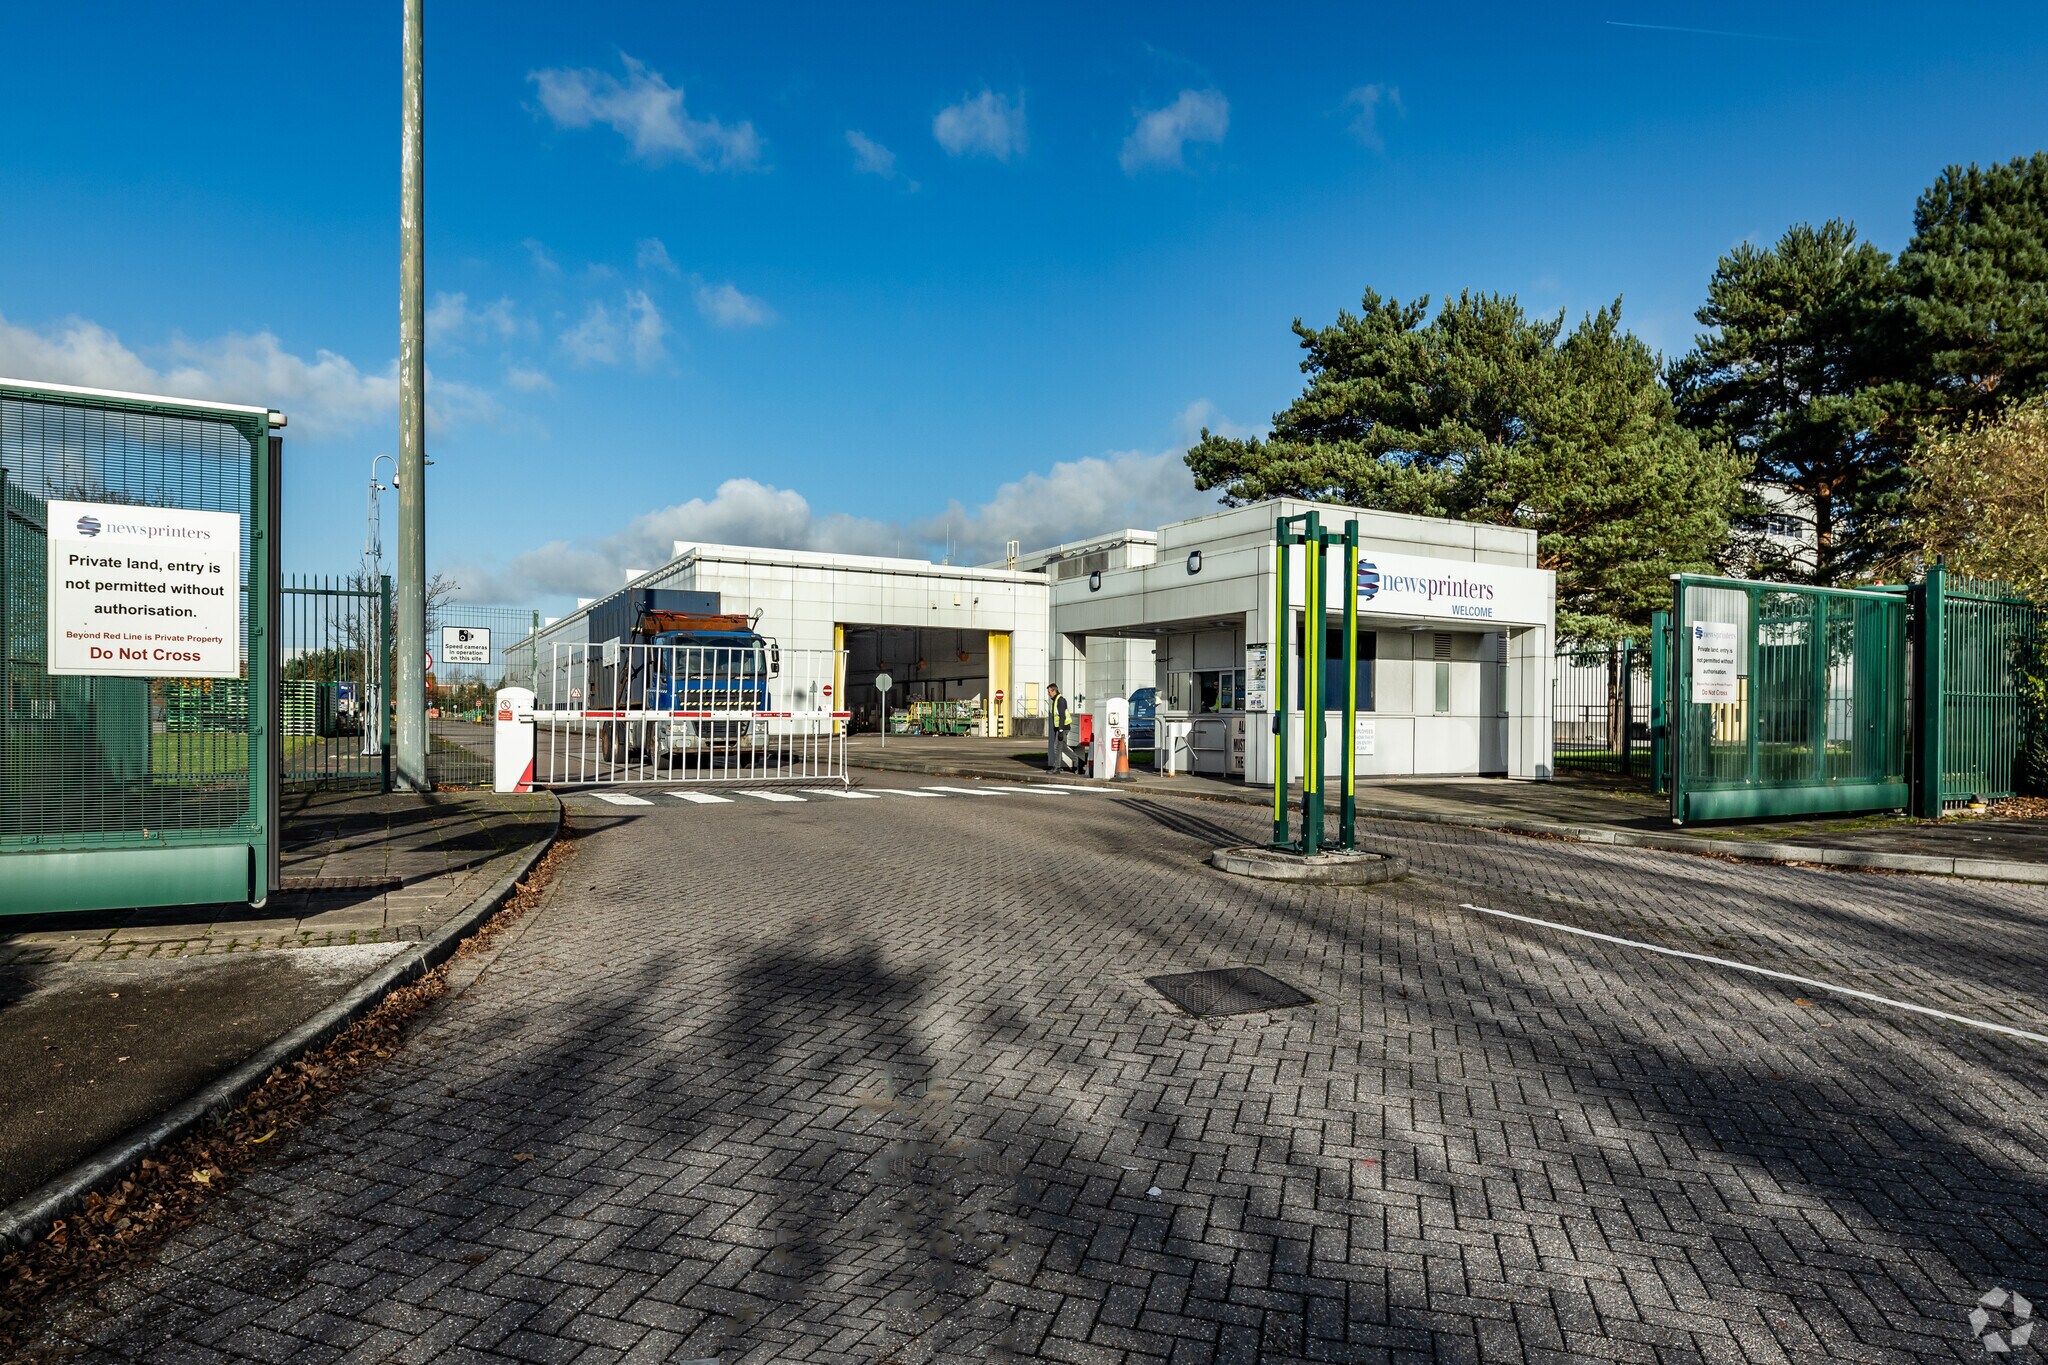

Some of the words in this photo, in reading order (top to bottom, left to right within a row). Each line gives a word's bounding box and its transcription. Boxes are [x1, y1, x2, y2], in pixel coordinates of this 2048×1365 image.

[107, 523, 211, 540] newsprinters
[69, 554, 122, 568] Private
[127, 557, 163, 572] land,
[167, 561, 204, 575] entry
[209, 562, 221, 573] is
[65, 579, 90, 590] not
[95, 580, 166, 594] permitted
[171, 584, 225, 596] without
[1383, 574, 1494, 601] newsprinters
[94, 604, 197, 617] authorisation.
[1451, 604, 1493, 618] WELCOME
[66, 631, 101, 640] Beyond
[103, 632, 121, 640] Red
[123, 633, 142, 641] Line
[154, 634, 185, 642] Private
[187, 635, 223, 644] Property
[90, 646, 114, 660] Do
[119, 647, 148, 661] Not
[153, 649, 201, 662] Cross
